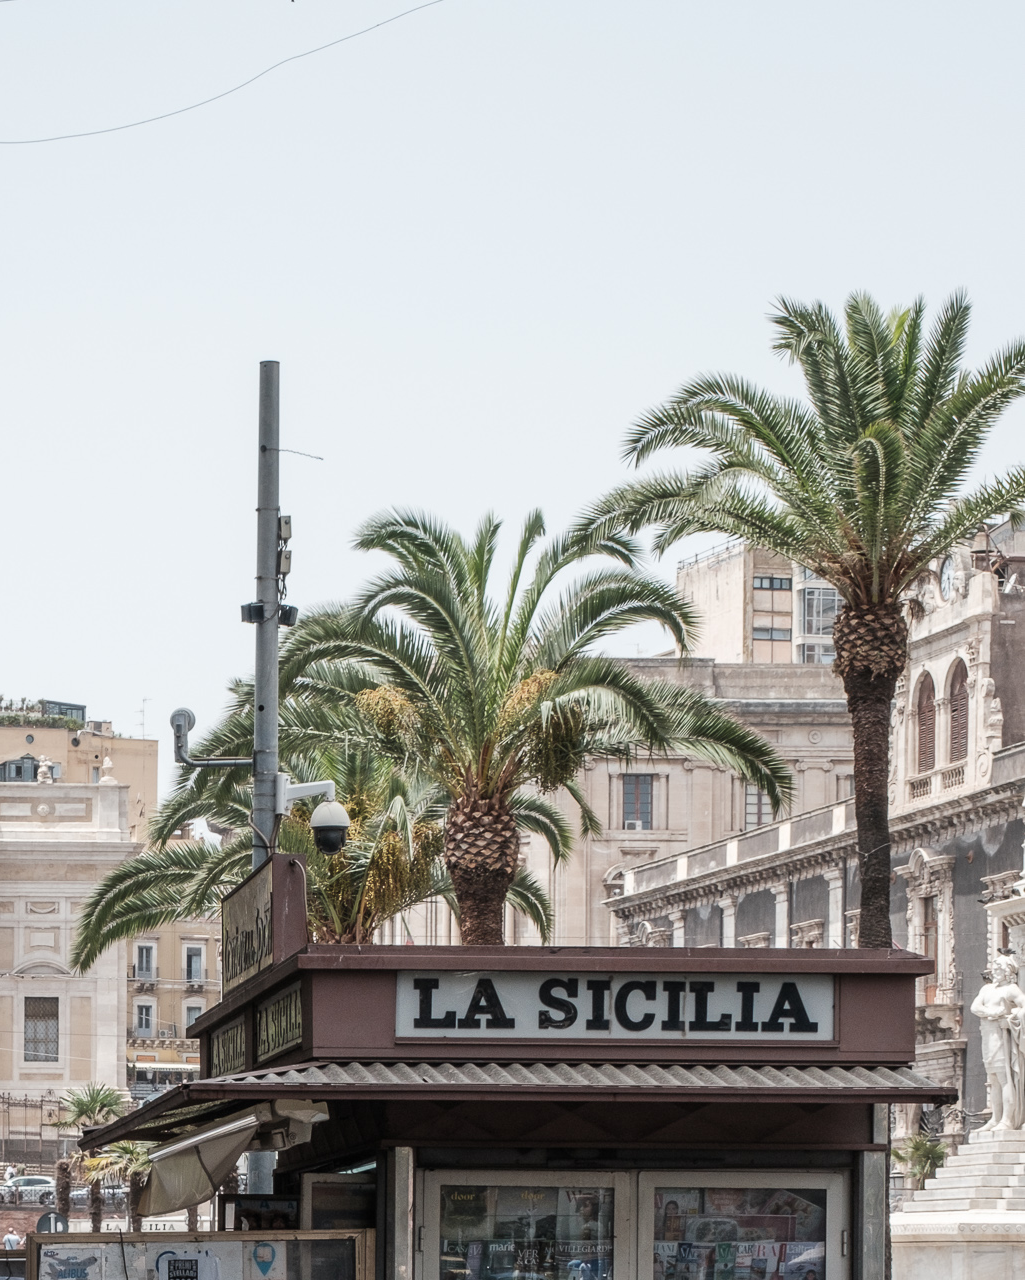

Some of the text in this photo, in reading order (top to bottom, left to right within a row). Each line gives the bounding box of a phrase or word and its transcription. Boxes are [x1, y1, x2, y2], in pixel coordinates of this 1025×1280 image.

[413, 977, 819, 1033] LA SICILIA
[451, 1190, 475, 1201] door
[521, 1190, 545, 1200] door
[489, 1242, 515, 1252] marie
[58, 1268, 88, 1278] ALIBUS
